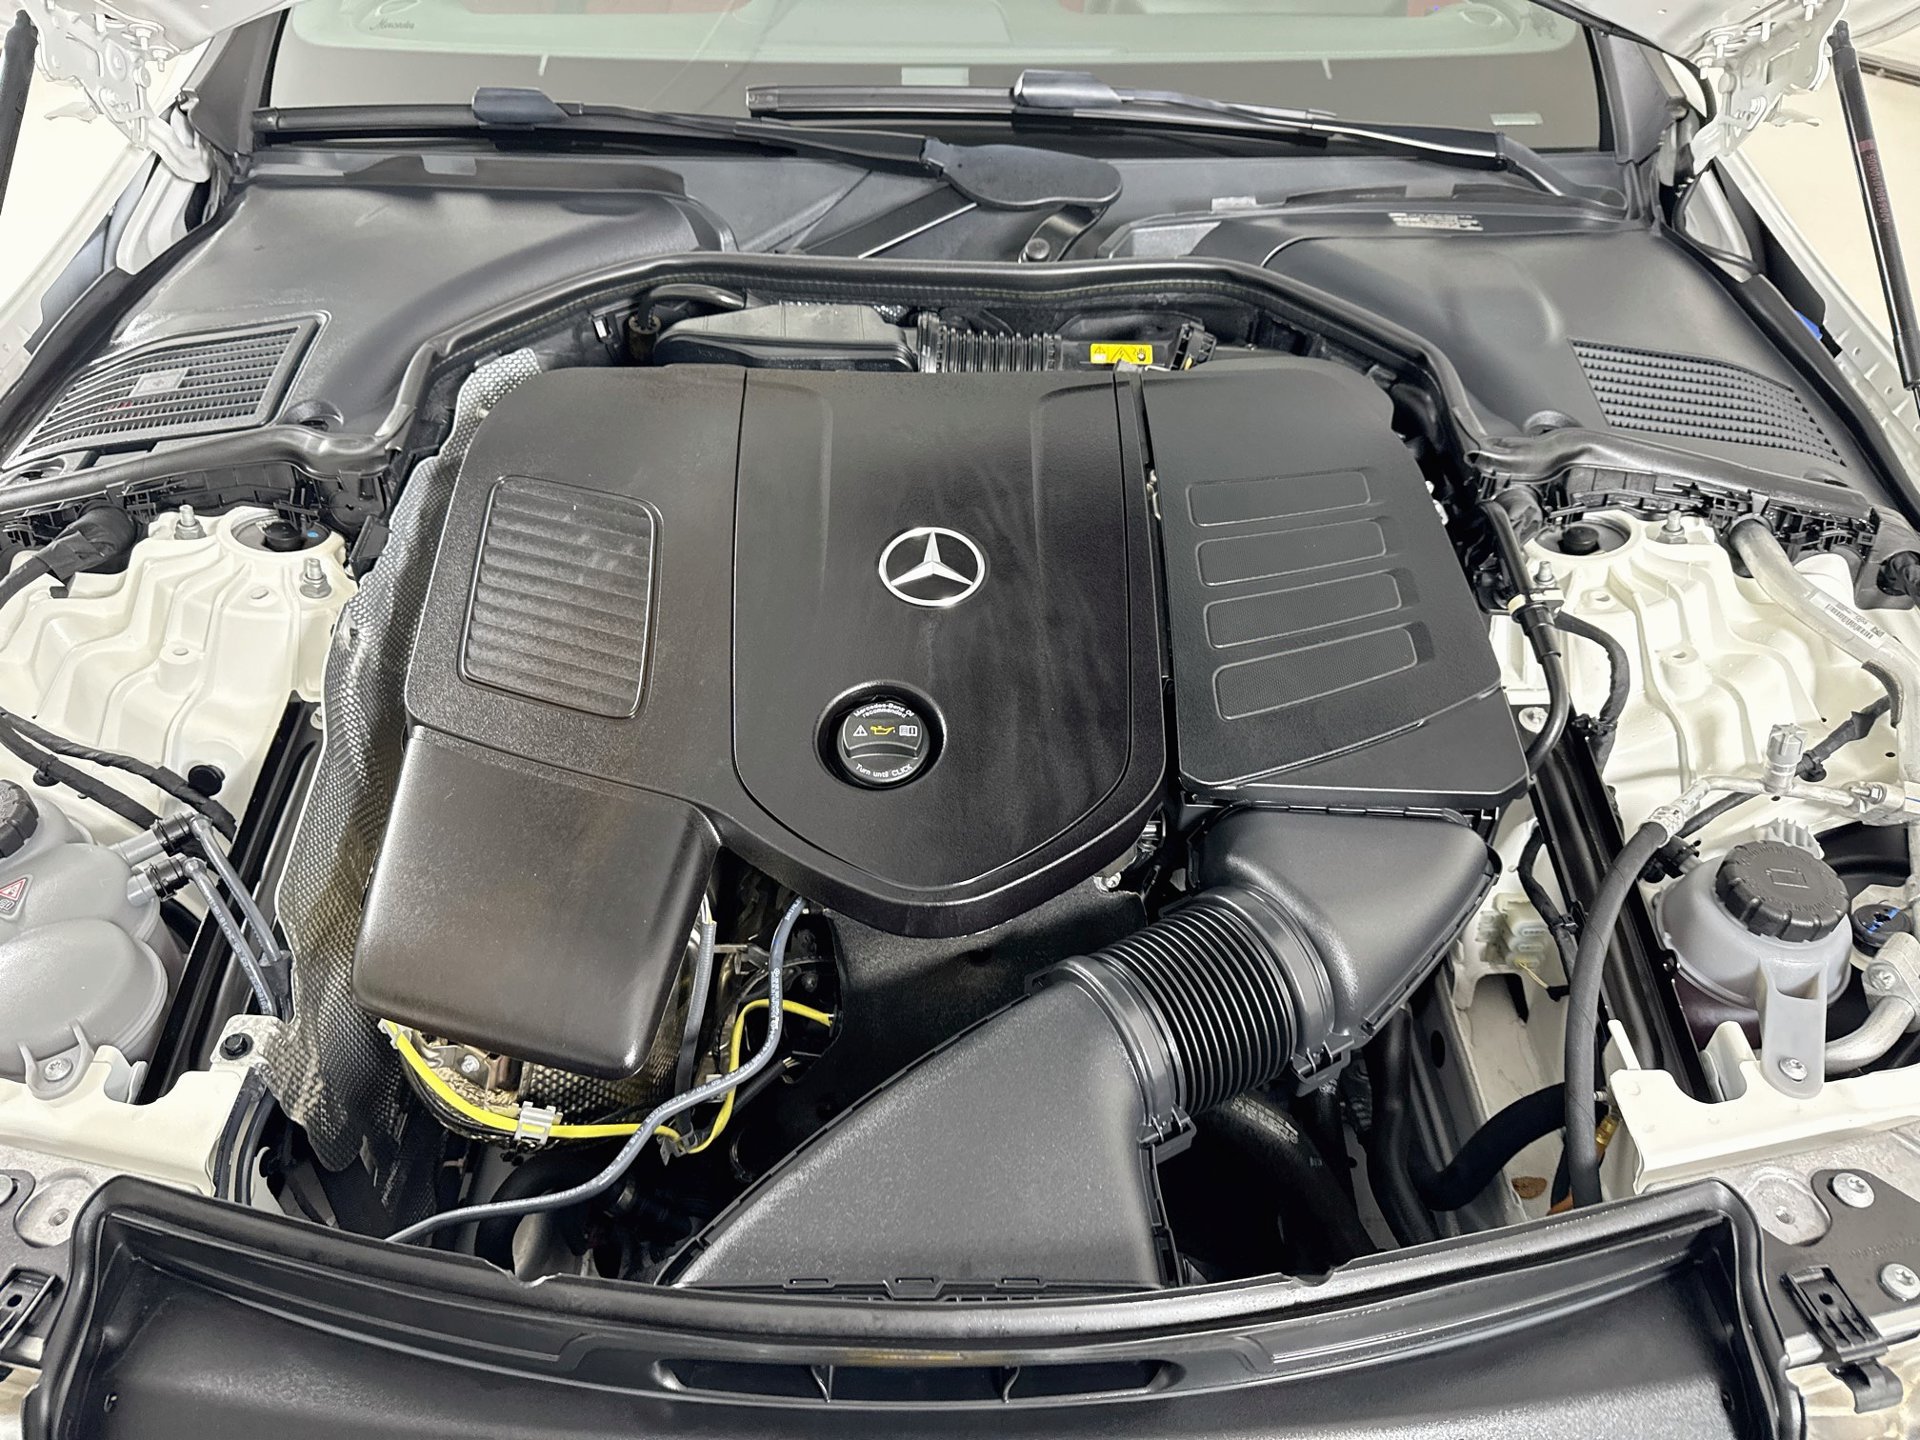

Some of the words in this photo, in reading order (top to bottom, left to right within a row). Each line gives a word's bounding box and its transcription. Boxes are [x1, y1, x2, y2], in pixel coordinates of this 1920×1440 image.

[853, 702, 906, 717] Mercedes-Benz
[862, 708, 907, 718] recommended
[856, 763, 871, 775] Turn
[872, 770, 889, 778] until
[891, 763, 913, 776] CLICK
